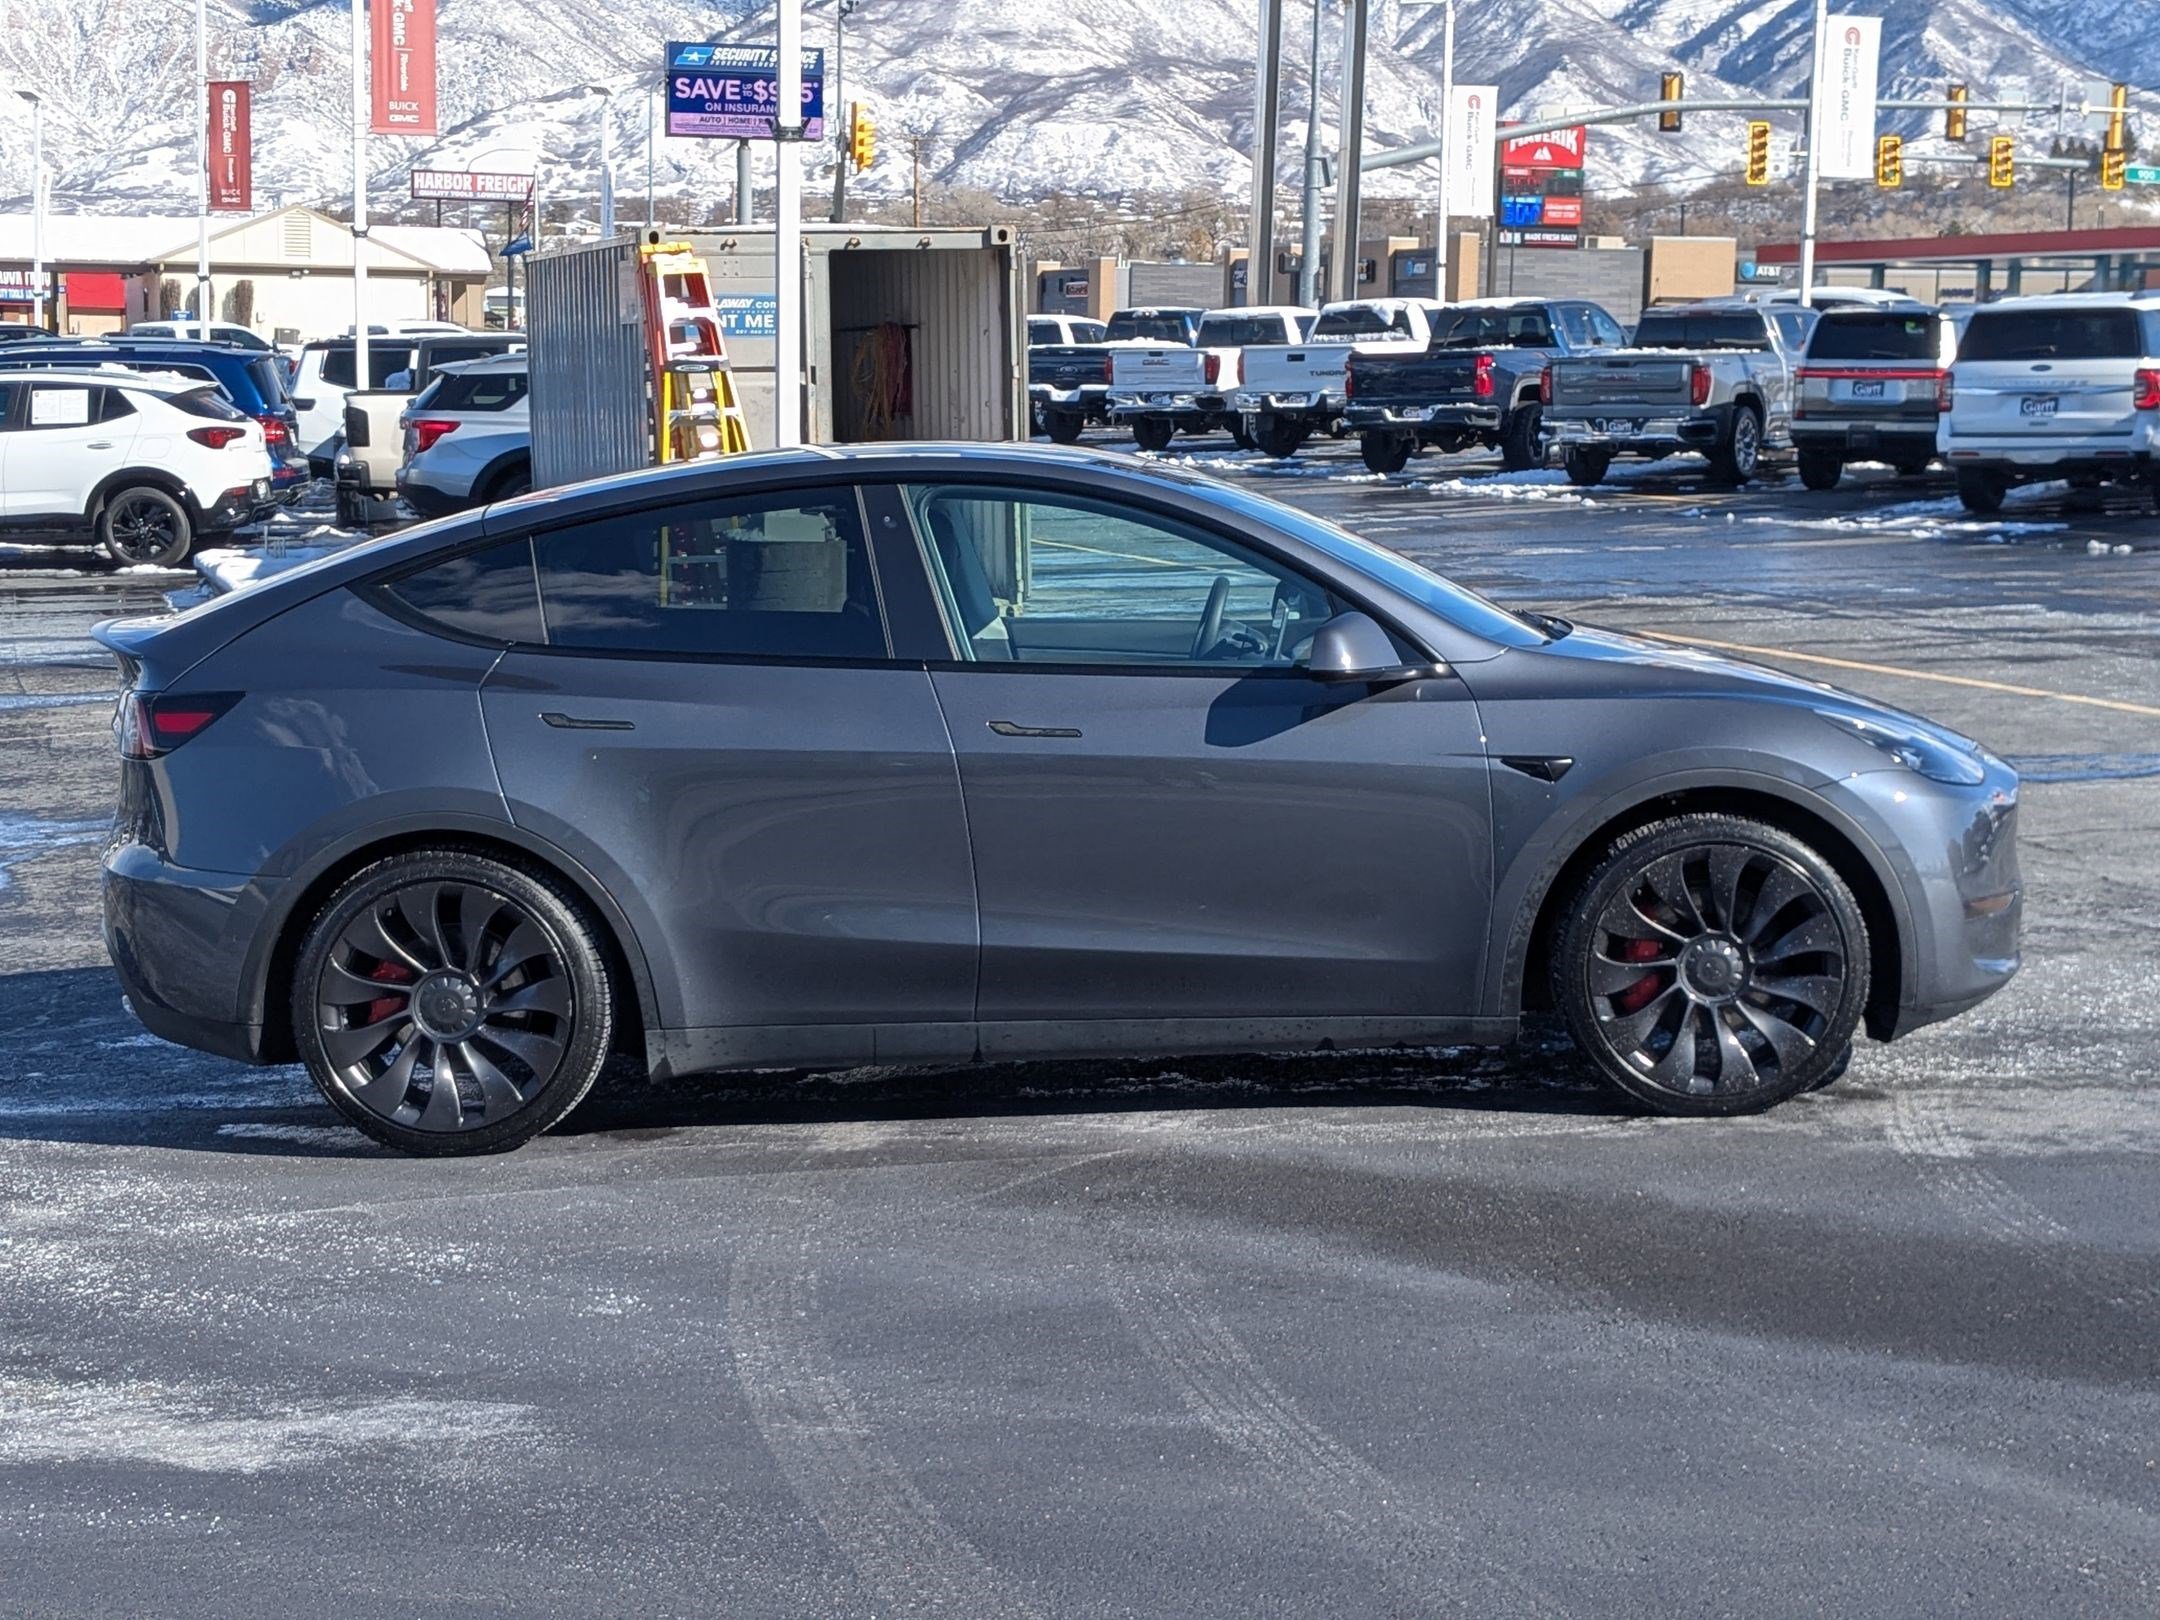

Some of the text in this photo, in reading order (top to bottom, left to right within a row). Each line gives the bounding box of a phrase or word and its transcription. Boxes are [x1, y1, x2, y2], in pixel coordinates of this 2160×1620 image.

[713, 47, 770, 61] SECURITY
[675, 77, 741, 100] SAVE
[389, 101, 420, 111] BUICK
[705, 102, 778, 113] ON INSURAN
[389, 114, 420, 123] GMC
[700, 116, 722, 124] AUTO
[728, 117, 751, 125] HOME
[414, 172, 473, 190] HARBOR
[1756, 265, 1781, 277] AT&T
[745, 314, 775, 328] ME
